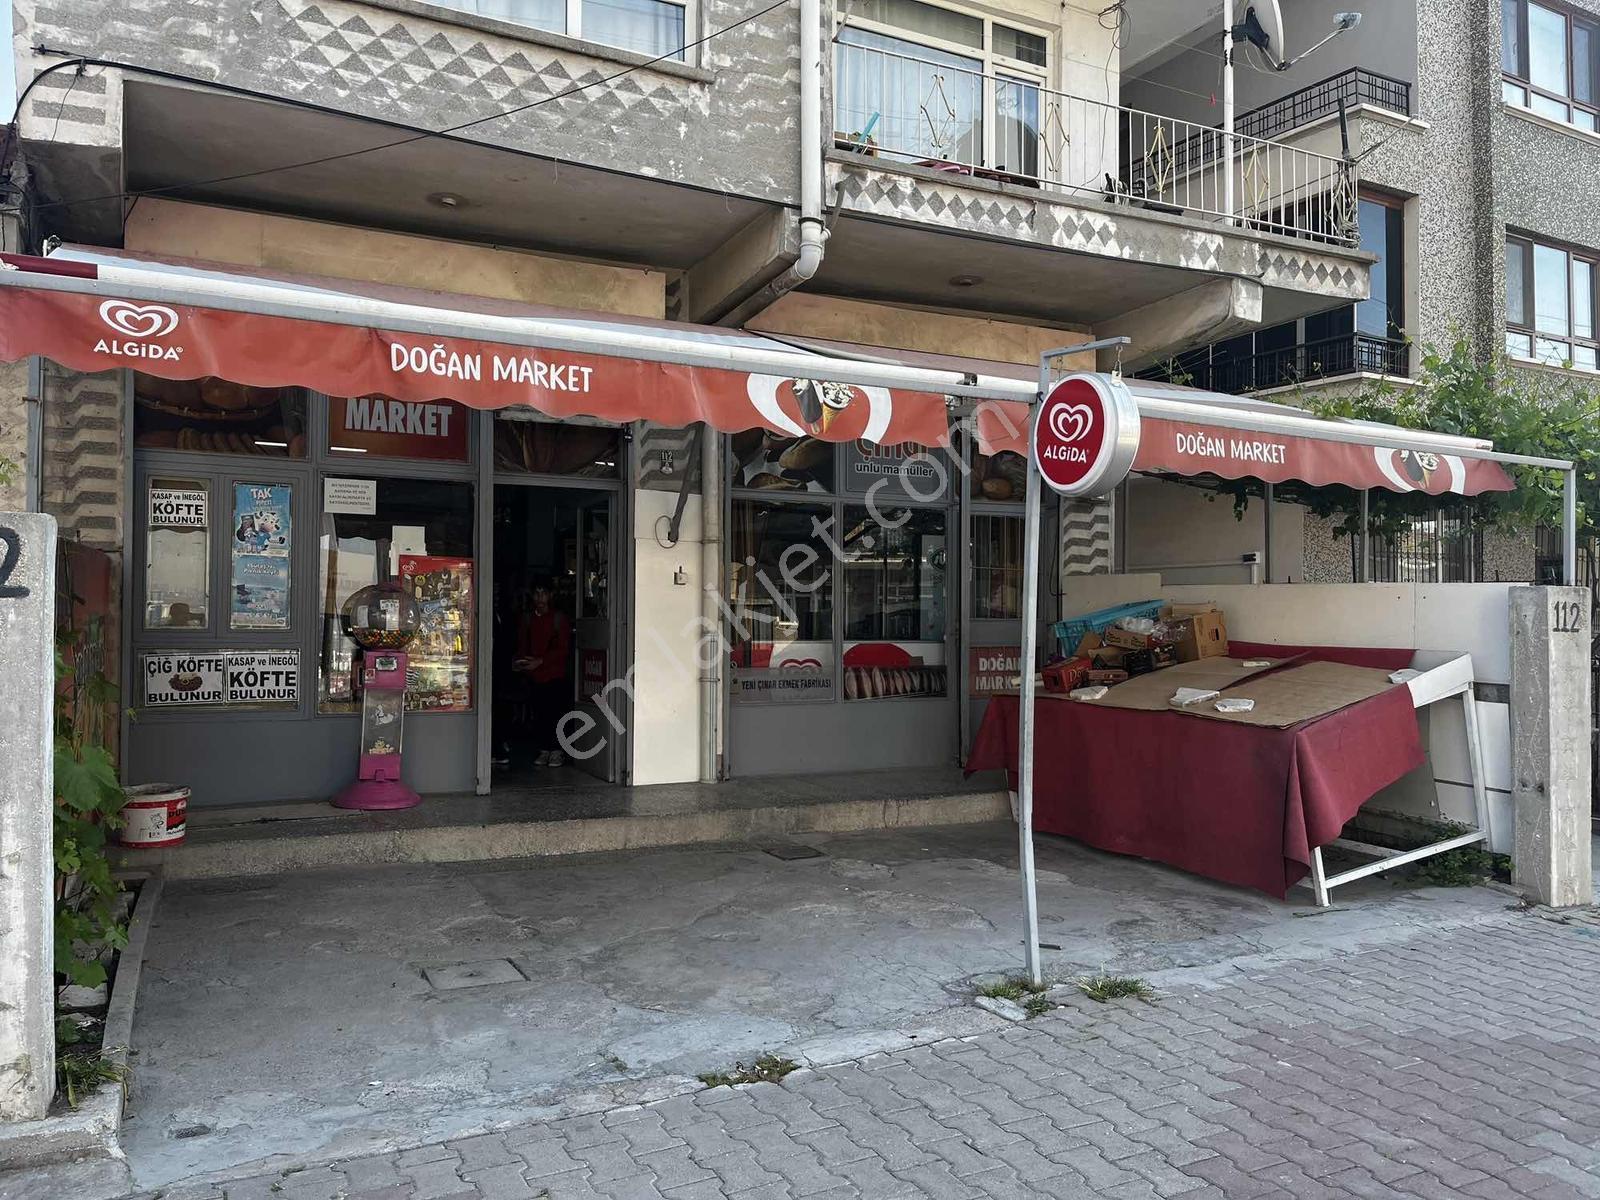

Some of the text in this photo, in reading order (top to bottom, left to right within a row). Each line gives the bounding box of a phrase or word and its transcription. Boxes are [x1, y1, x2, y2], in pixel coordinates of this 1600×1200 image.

[390, 342, 593, 392] DOĞAN MARKET
[344, 397, 453, 437] MARKET
[1176, 431, 1286, 464] DOĞAN MARKET
[855, 462, 934, 477] unlu mamüller
[151, 491, 173, 500] KASAP
[181, 491, 205, 501] İNEGÖL
[251, 488, 273, 499] TAK
[152, 501, 204, 516] KÖFTE
[152, 516, 204, 525] BULUNUR
[1552, 601, 1580, 632] 112
[147, 656, 223, 678] ÇİĞ KÖFTE
[228, 654, 298, 667] KASAP ve İNEGÖL
[229, 667, 297, 688] KÖFTE
[741, 679, 756, 690] YENİ
[975, 676, 1013, 691] MARK
[148, 690, 222, 703] BULUNUR
[229, 688, 296, 700] BULUNUR
